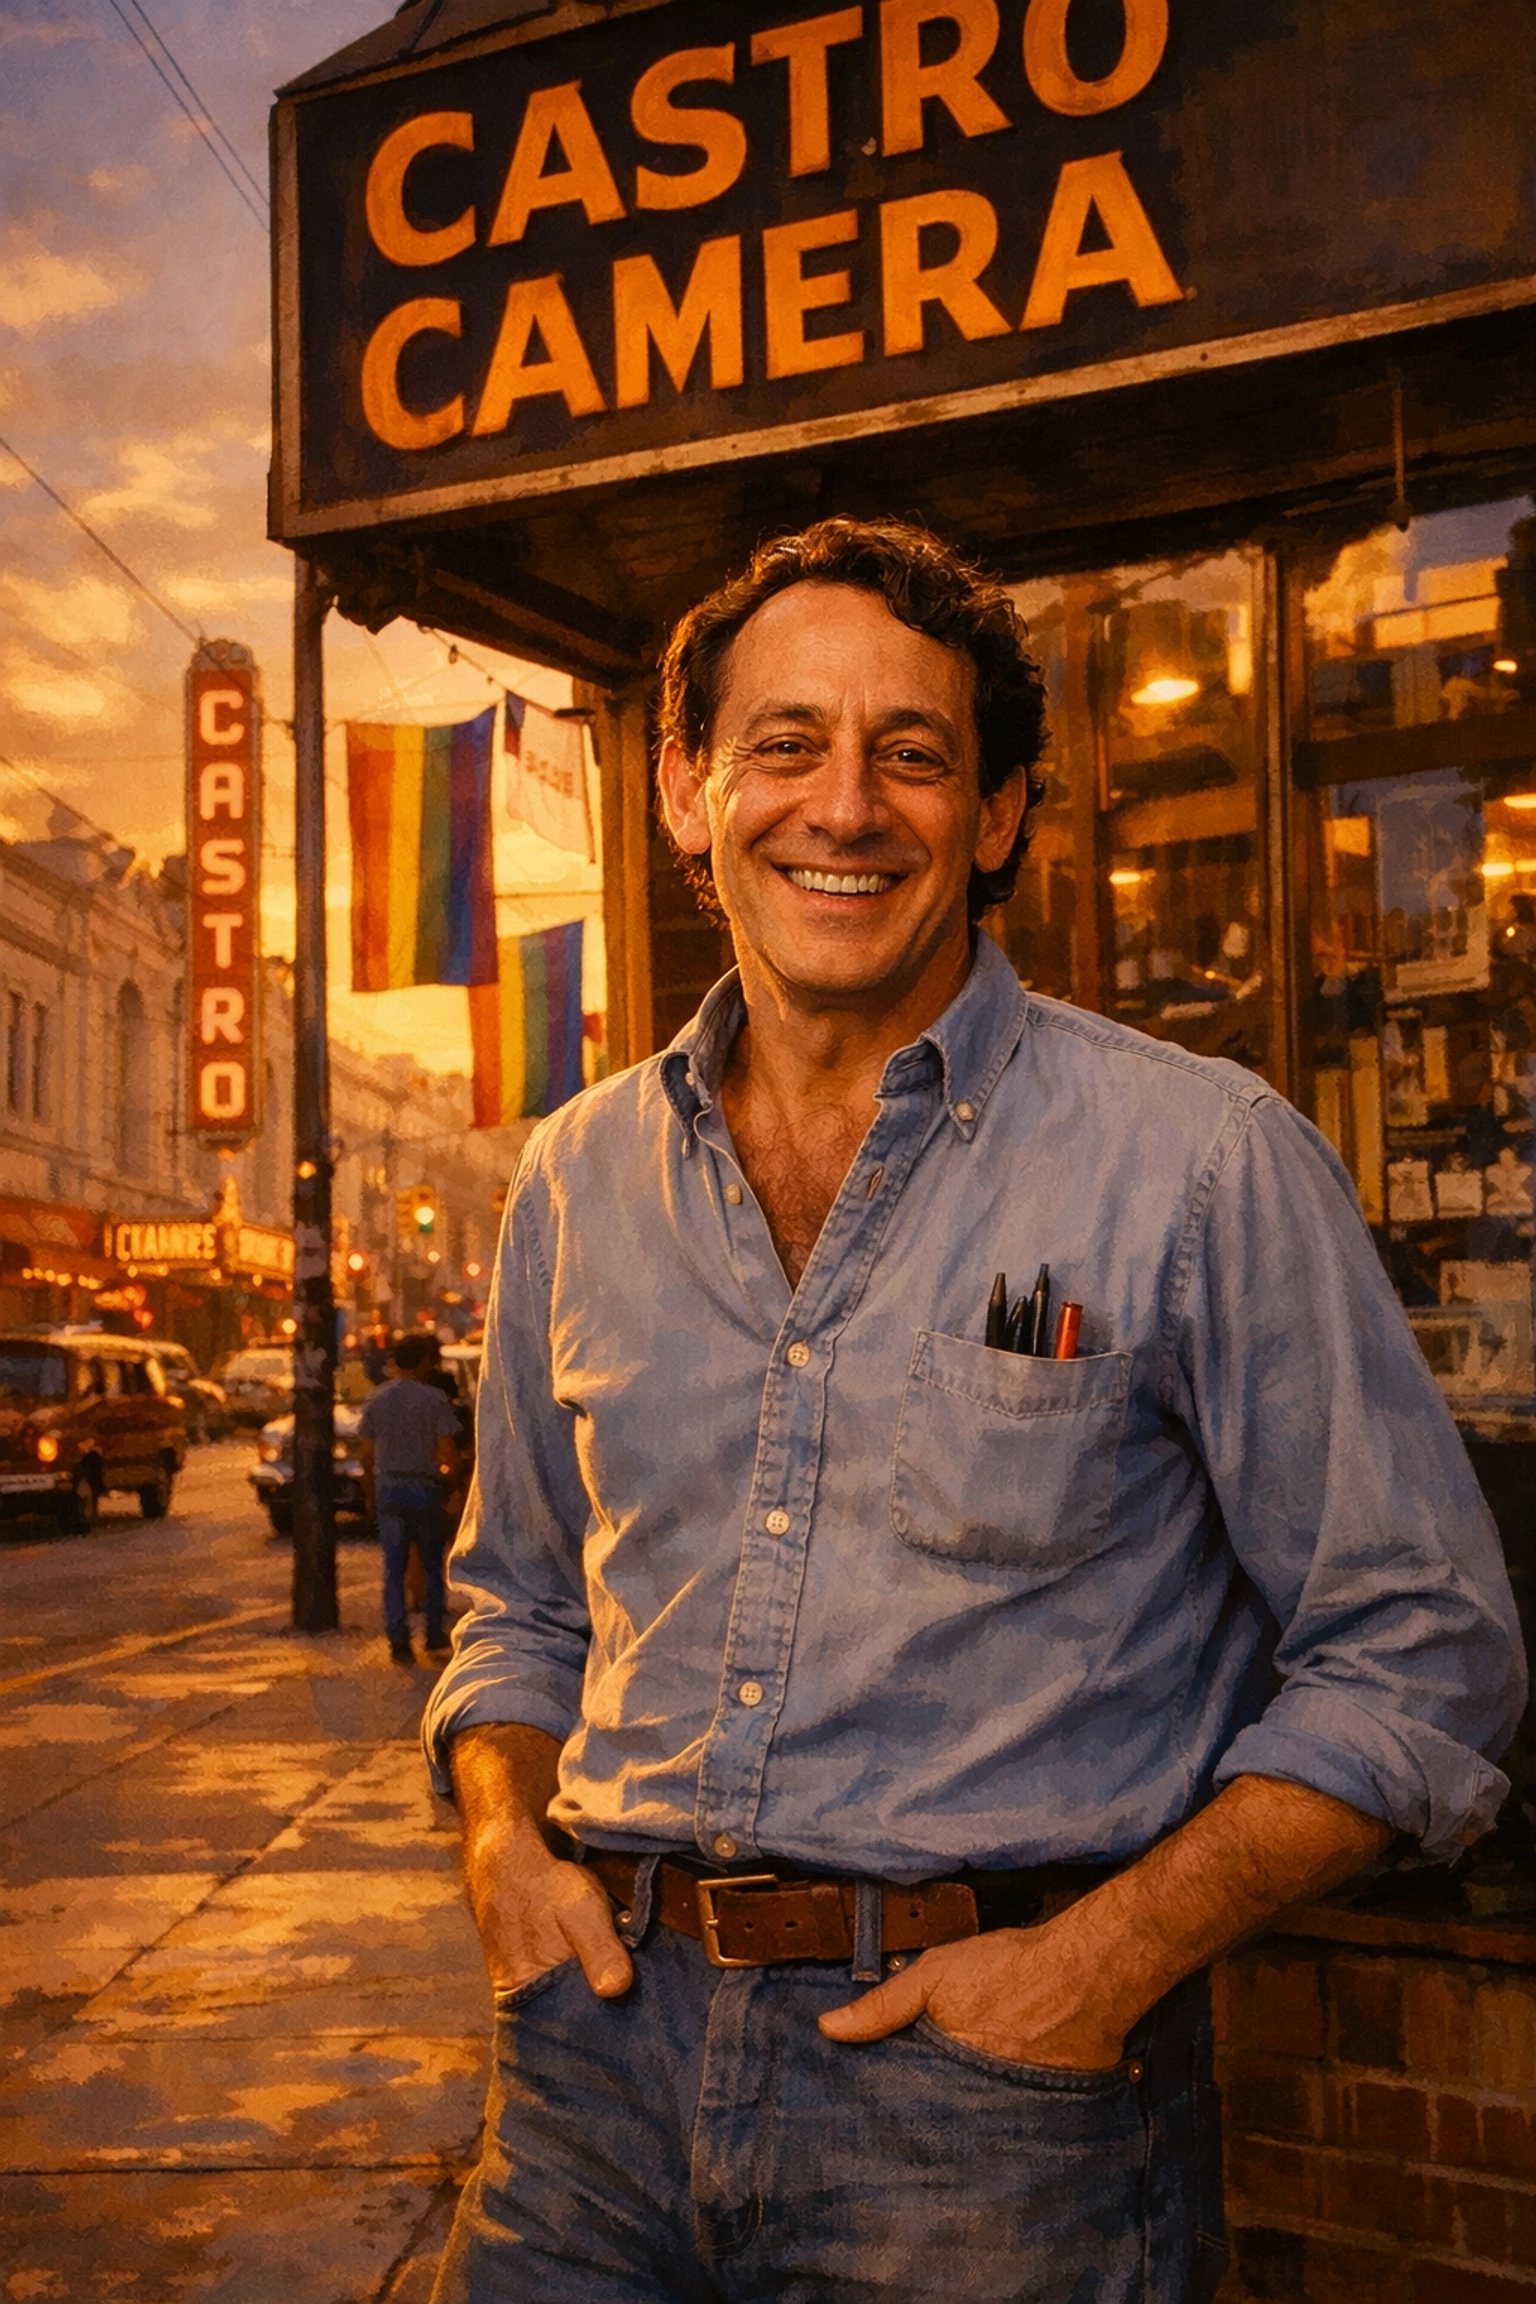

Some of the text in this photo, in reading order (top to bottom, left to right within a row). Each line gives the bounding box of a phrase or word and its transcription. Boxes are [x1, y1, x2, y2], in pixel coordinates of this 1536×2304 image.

[365, 0, 1168, 266] CASTRO
[361, 151, 1184, 450] CAMERA
[197, 688, 246, 1120] CASTRO
